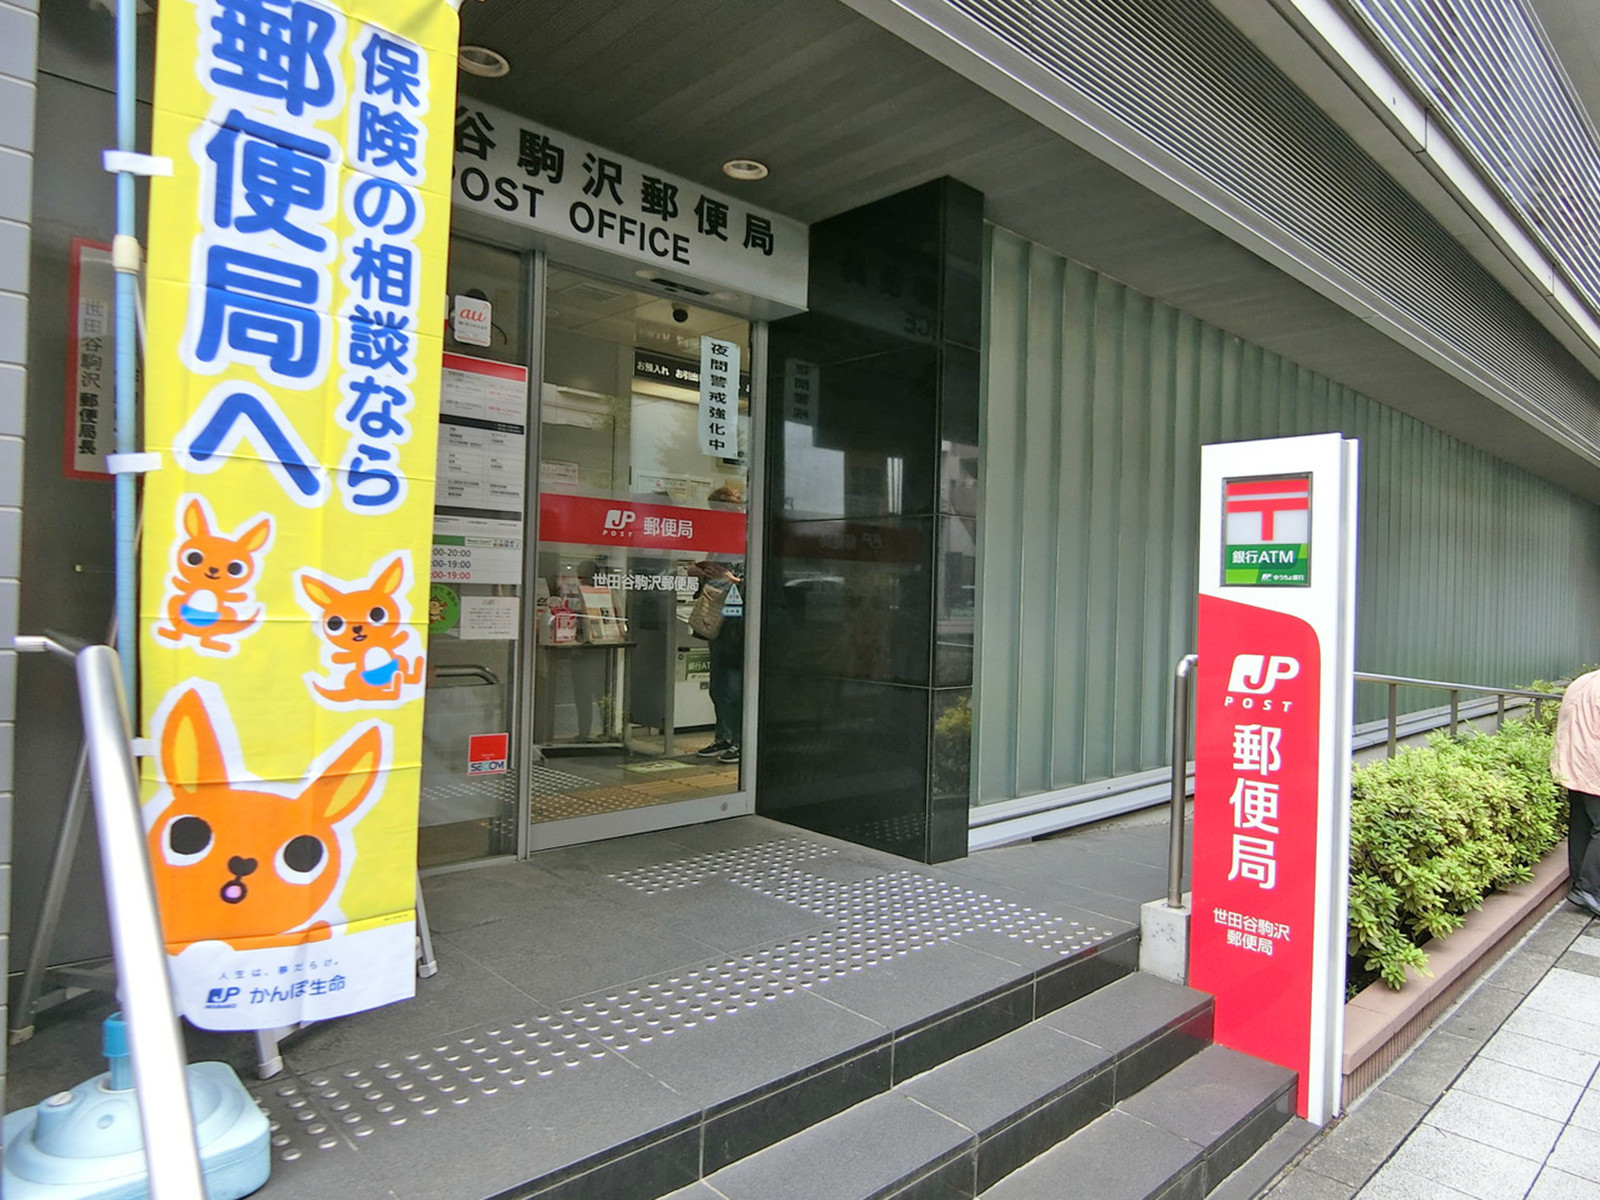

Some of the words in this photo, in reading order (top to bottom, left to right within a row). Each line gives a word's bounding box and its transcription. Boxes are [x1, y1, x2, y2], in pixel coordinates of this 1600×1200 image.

[453, 164, 544, 217] OST
[569, 201, 690, 265] OFFICE
[189, 0, 337, 496] 郵便局へ
[347, 33, 421, 506] 保険の相談なら
[459, 308, 487, 322] au
[675, 369, 700, 382] お引出
[708, 342, 730, 450] 夜間警戒強化中
[602, 530, 633, 538] POST
[604, 509, 636, 530] JP
[644, 517, 693, 539] 郵便局
[1231, 550, 1294, 564] 銀行ATM
[592, 573, 700, 593] 世田谷駒沢郵便局
[1227, 654, 1300, 694] JP
[1224, 696, 1292, 712] POST
[1228, 723, 1282, 890] 郵便局
[1213, 907, 1290, 942] 世田谷駒沢
[1226, 928, 1273, 956] 郵便局
[206, 986, 241, 1004] JP
[249, 974, 347, 1005] かんぽ生命
